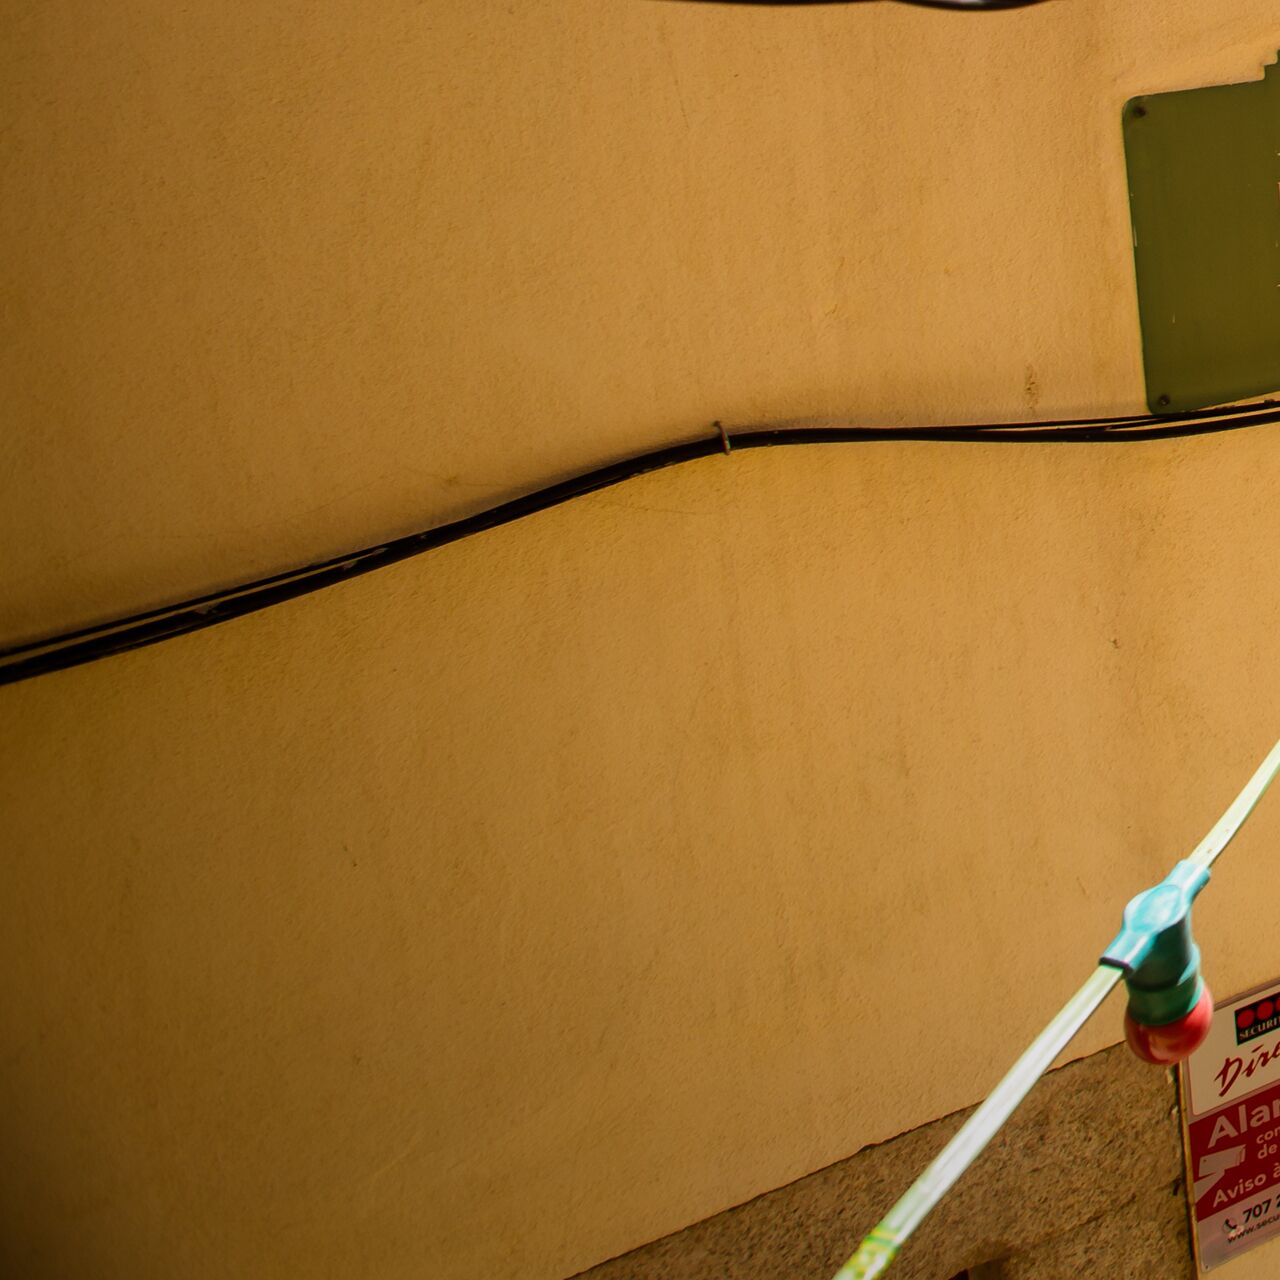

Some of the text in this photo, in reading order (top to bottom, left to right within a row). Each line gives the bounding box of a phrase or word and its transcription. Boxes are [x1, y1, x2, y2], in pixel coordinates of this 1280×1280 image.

[1257, 1143, 1278, 1159] de
[1212, 1174, 1267, 1208] Aviso
[1243, 1198, 1272, 1224] 707
